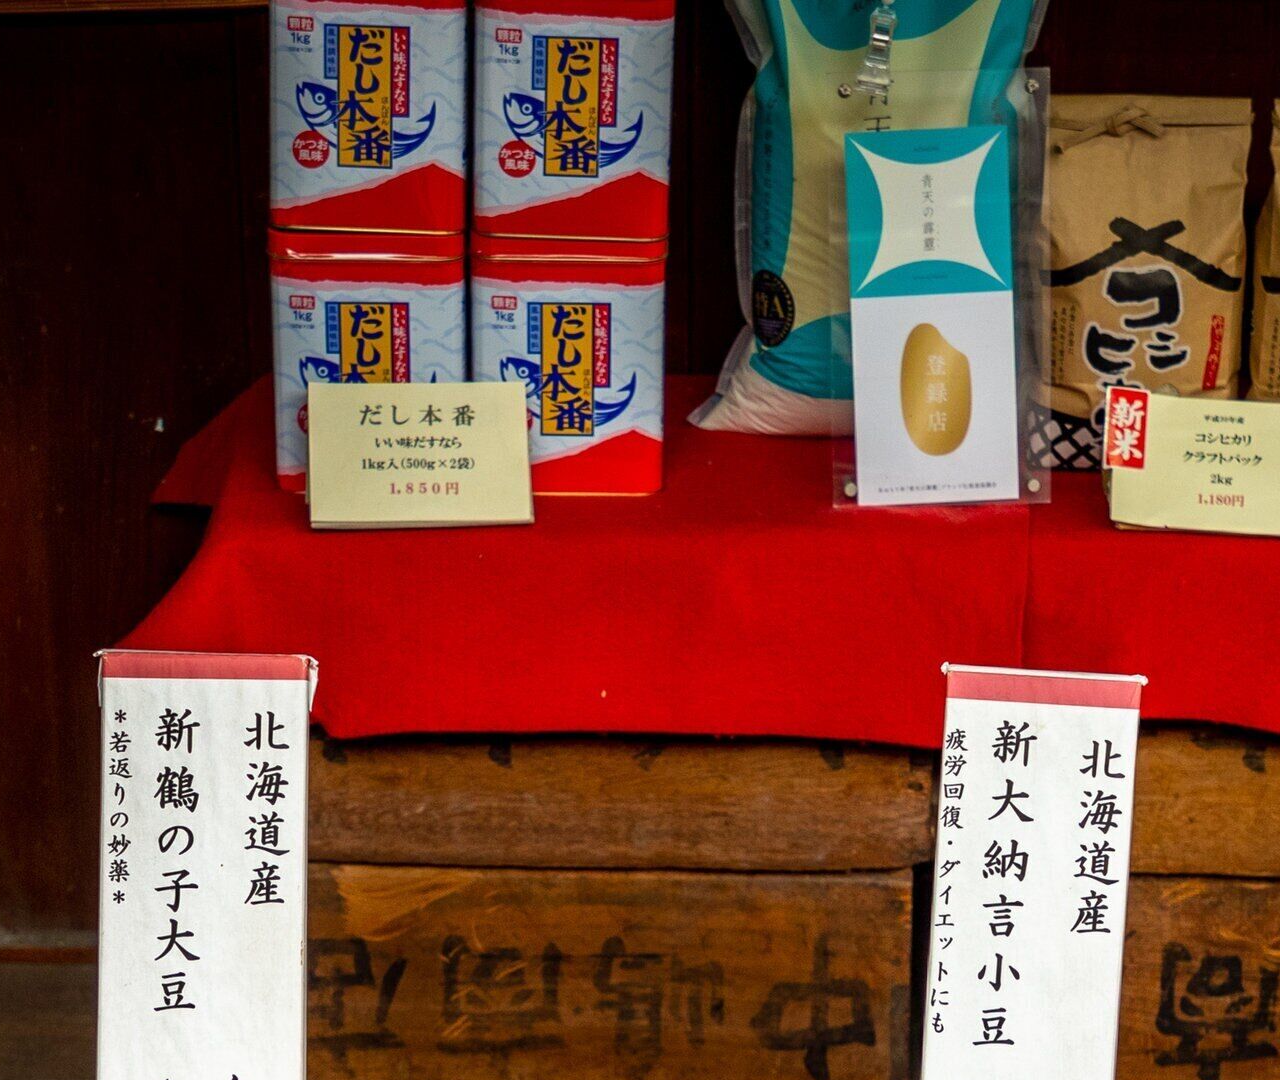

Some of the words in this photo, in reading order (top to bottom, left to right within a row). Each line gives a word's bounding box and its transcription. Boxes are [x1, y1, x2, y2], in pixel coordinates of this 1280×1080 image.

[290, 32, 311, 45] 1kg
[498, 43, 520, 57] 1kg
[393, 31, 406, 114] いい味だすなら
[601, 43, 615, 124] いい味だすなら
[338, 27, 393, 165] だし本番
[543, 39, 599, 174] だし本番
[294, 138, 328, 150] かつお
[299, 150, 324, 162] 風味
[500, 148, 535, 160] かつお
[504, 159, 530, 171] 風味
[594, 307, 608, 385] いい味だすなら
[539, 304, 594, 433] だし本番
[359, 404, 476, 428] だし本番
[1109, 396, 1145, 461] 新米
[1194, 432, 1252, 447] コシヒカリ
[374, 436, 463, 450] いい味だすなら
[1183, 450, 1263, 467] クラフトパック
[389, 481, 460, 497] 1,850円
[1209, 473, 1233, 486] 2kg
[1197, 493, 1245, 508] 1,180円
[243, 710, 290, 906] 北海道産
[1070, 739, 1126, 935] 北海道産
[153, 707, 201, 1013] 新鶴の子大豆
[929, 727, 970, 1035] 疲労回復・ダイエットにも
[971, 719, 1039, 1047] 新大納言小豆
